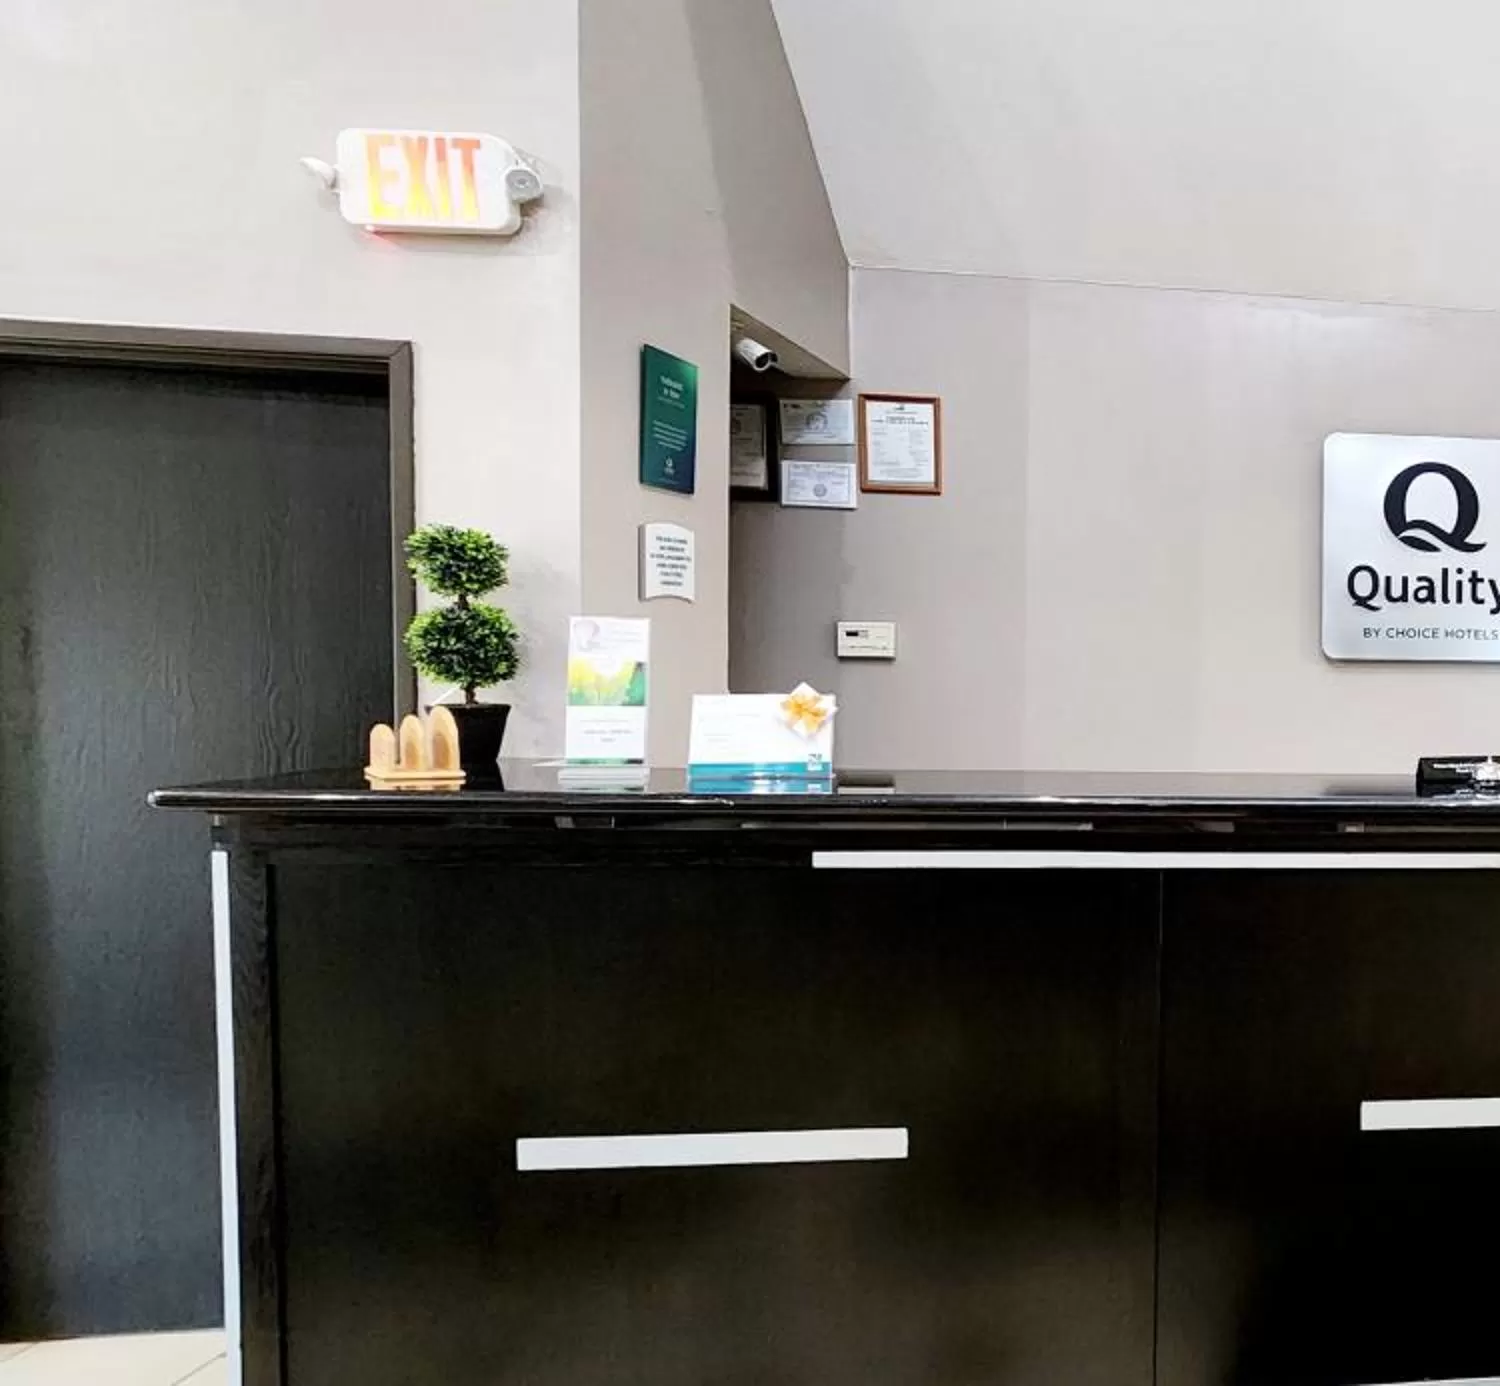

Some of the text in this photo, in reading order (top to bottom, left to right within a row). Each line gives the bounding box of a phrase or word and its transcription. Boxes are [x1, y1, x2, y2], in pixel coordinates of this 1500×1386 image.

[366, 134, 481, 221] EXIT
[1383, 461, 1487, 553] Q
[1363, 627, 1499, 640] BY CHOICE HOTELS
